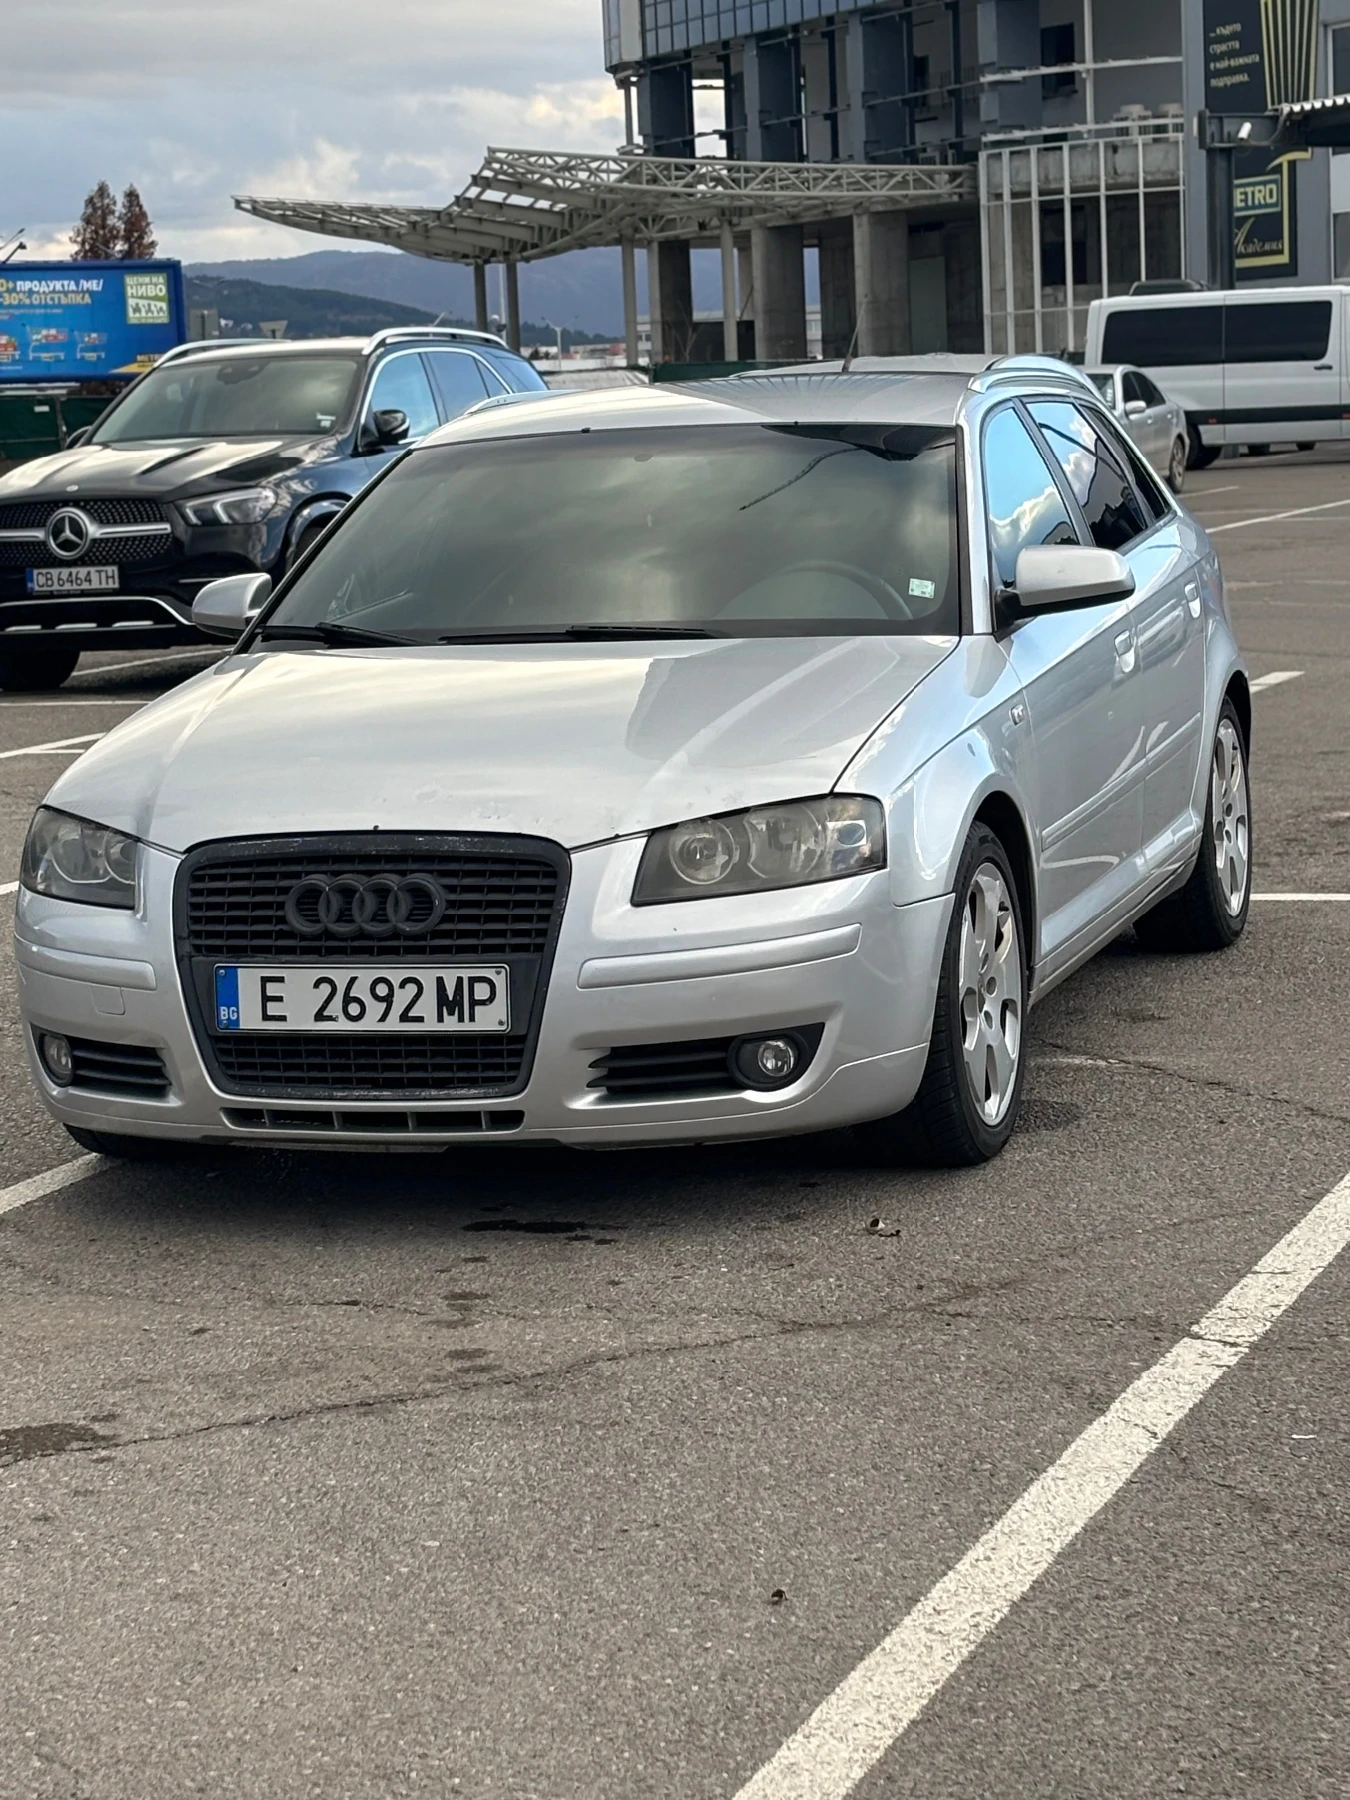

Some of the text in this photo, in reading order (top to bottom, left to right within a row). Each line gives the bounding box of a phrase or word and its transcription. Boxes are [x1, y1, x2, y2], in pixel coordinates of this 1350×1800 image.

[1209, 40, 1240, 55] страстта
[1234, 184, 1277, 207] ETRO
[16, 280, 76, 293] ПРОДУКТА
[126, 275, 164, 284] ЦЕНИ НА
[127, 284, 166, 297] НИВО
[32, 293, 91, 304] ОТСТЪПКА
[36, 571, 54, 588] CB
[57, 570, 92, 588] 6464
[95, 569, 116, 586] TH
[260, 976, 497, 1023] E 2692 MP
[219, 1006, 238, 1020] BG
